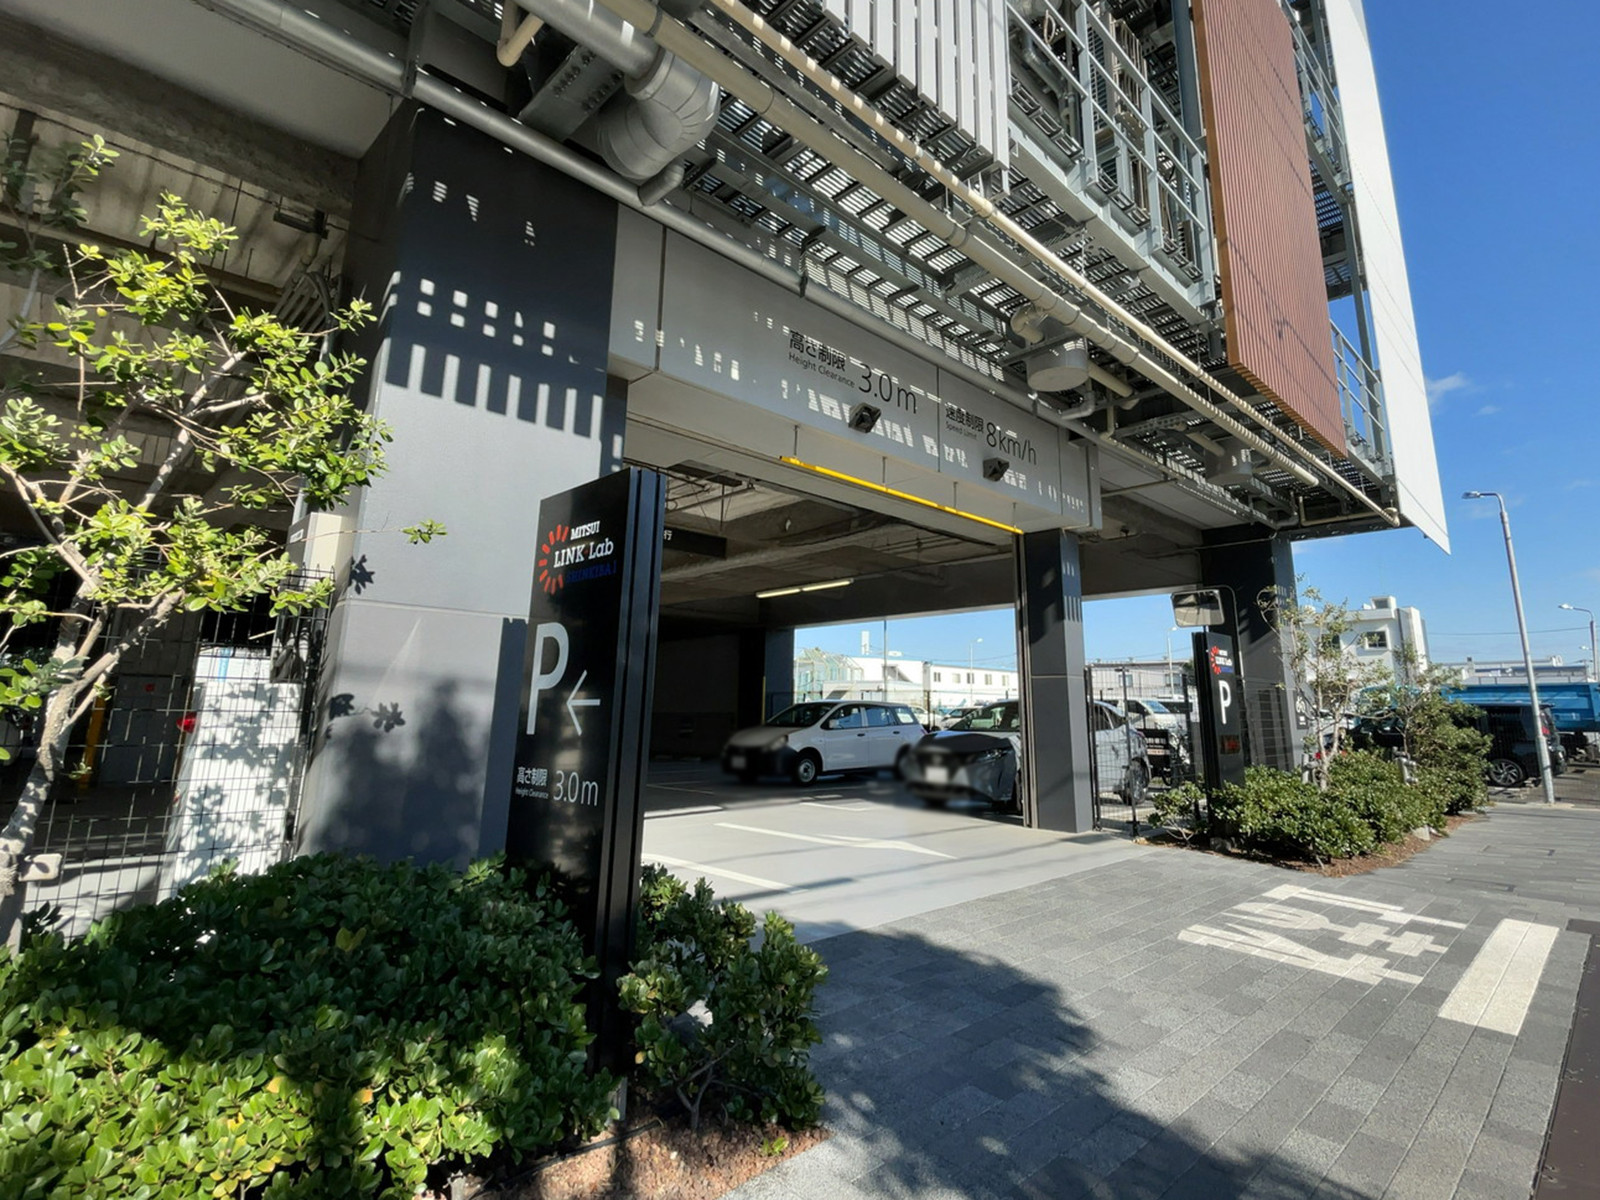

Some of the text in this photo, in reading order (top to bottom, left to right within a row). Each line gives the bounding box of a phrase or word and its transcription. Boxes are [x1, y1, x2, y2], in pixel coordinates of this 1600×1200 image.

[788, 351, 856, 388] Height Clearance
[789, 329, 846, 372] 高さ制限
[945, 407, 984, 433] 速度制限
[570, 520, 601, 541] MITSUI
[526, 621, 570, 736] P
[1218, 679, 1232, 725] P
[516, 766, 549, 787] 高さ制限
[1177, 883, 1467, 985] 止まれ
